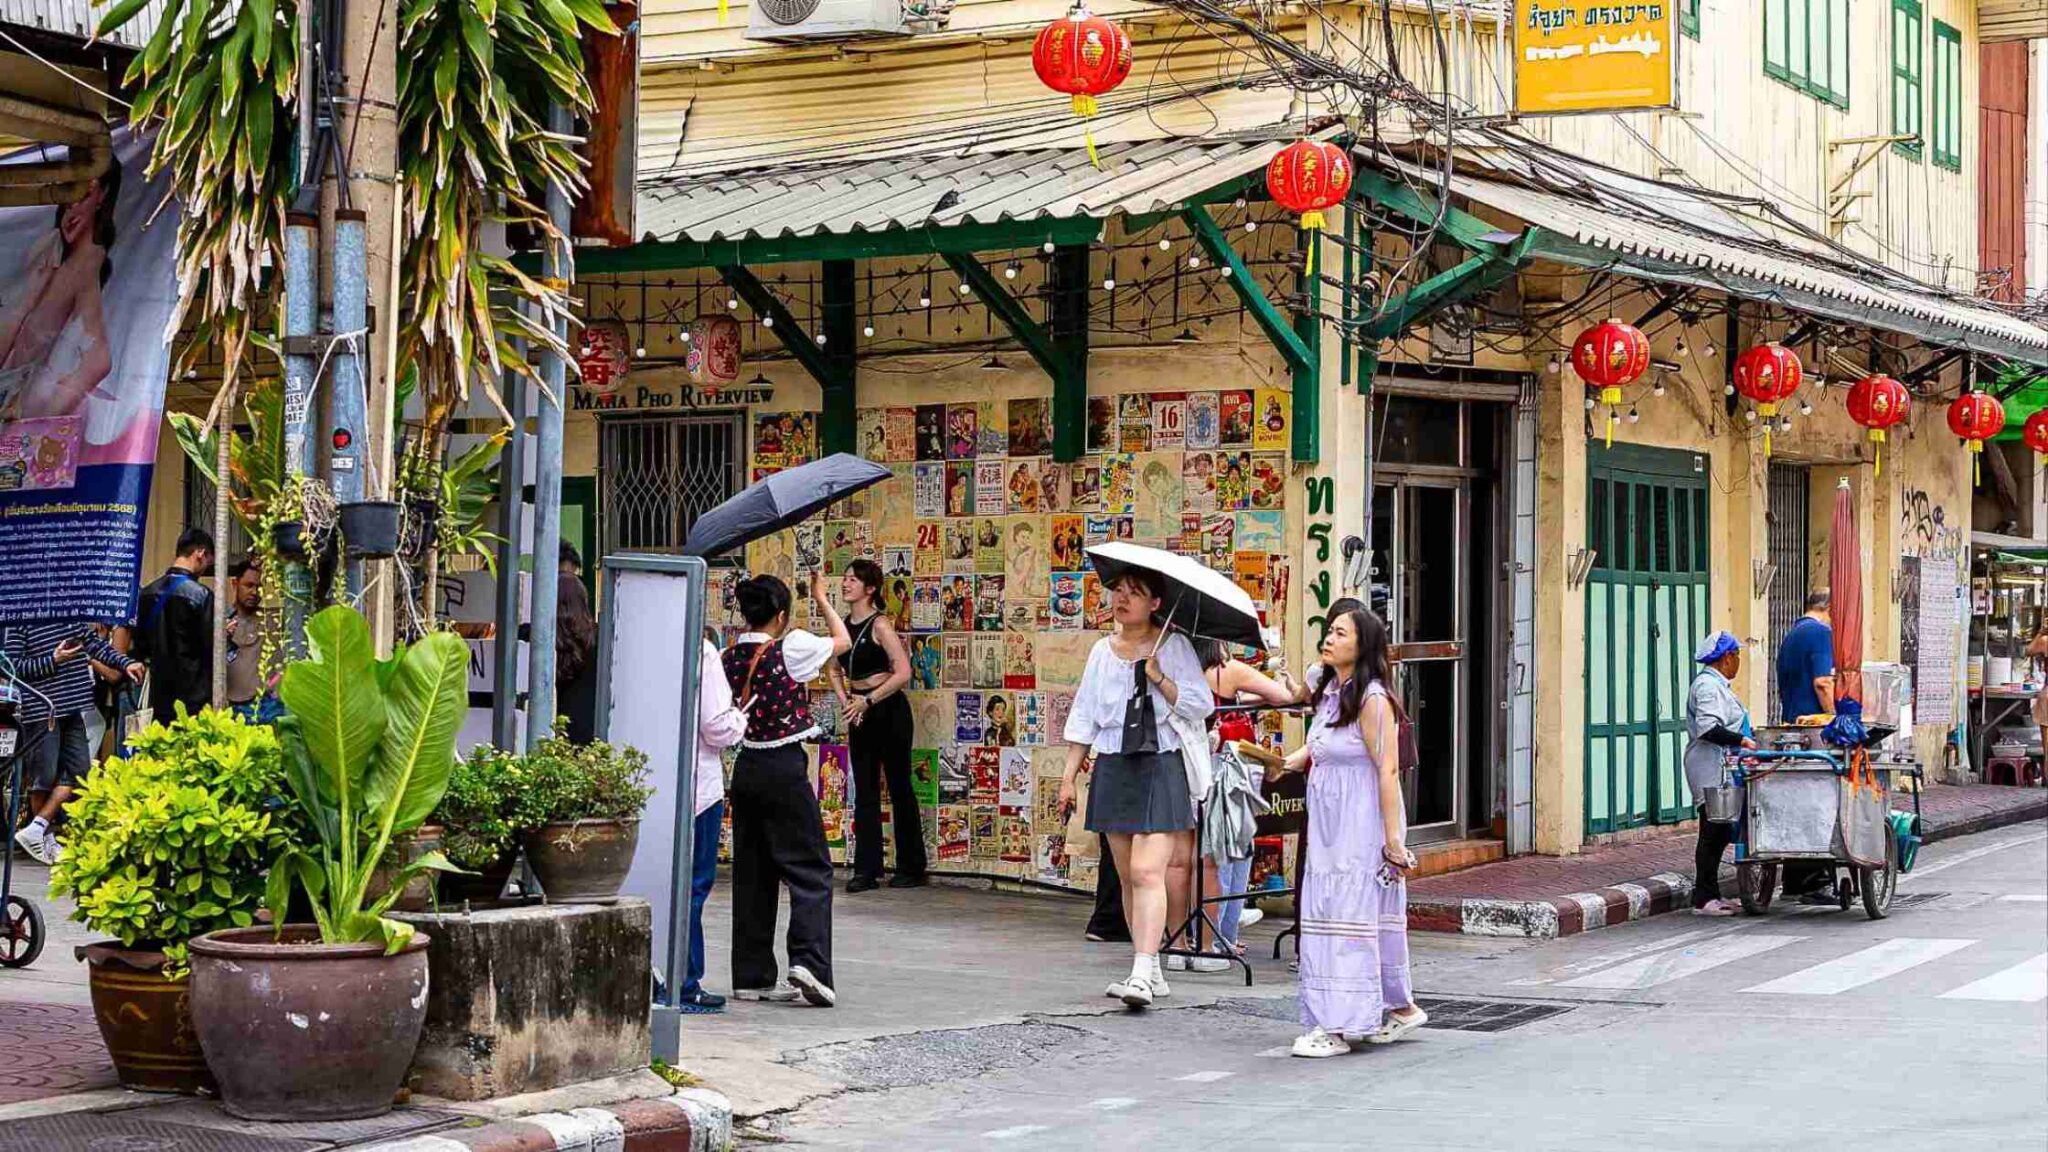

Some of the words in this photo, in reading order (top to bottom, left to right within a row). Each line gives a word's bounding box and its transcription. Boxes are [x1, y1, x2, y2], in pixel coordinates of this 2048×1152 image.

[637, 386, 673, 408] PHO
[680, 384, 775, 408] RIVERVIEW
[1160, 406, 1179, 429] 16
[917, 524, 938, 549] 24
